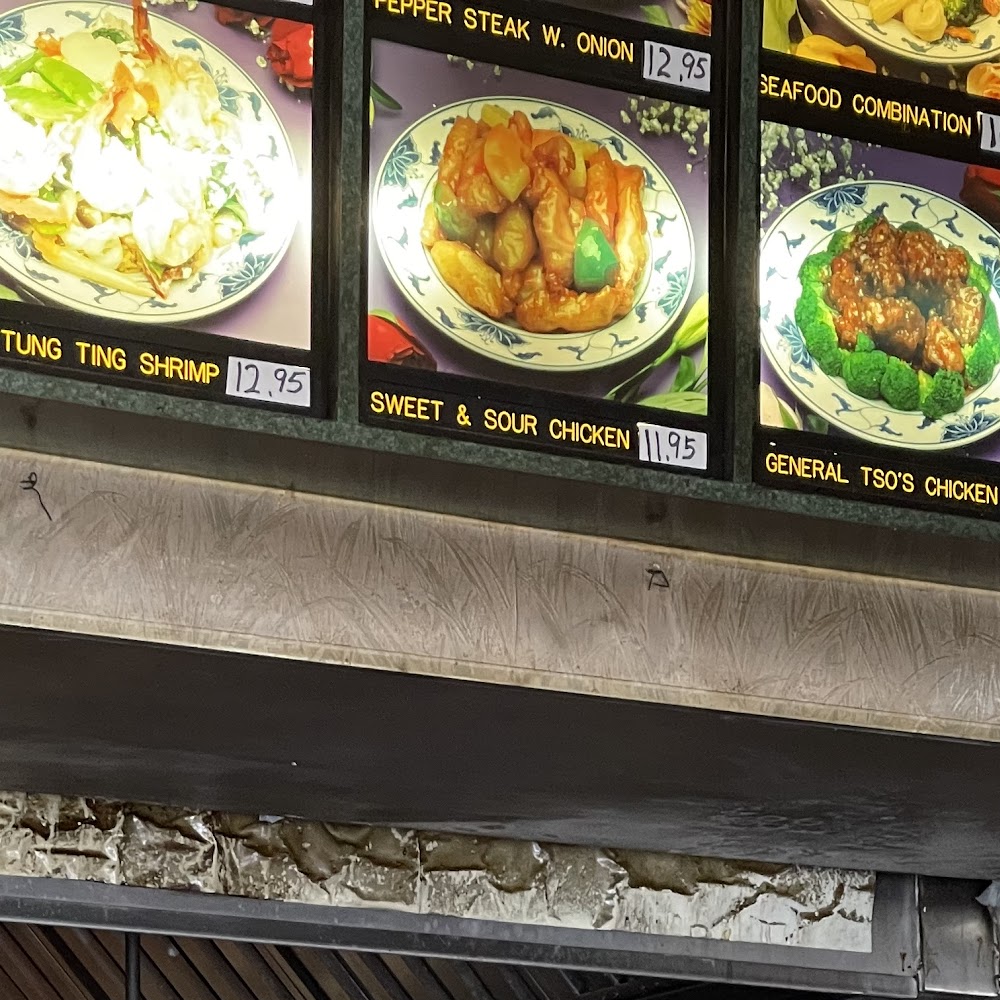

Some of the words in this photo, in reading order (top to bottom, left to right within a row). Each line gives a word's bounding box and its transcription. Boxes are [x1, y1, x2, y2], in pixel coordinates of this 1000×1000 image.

[464, 10, 530, 41] STEAK
[543, 24, 565, 48] W.
[577, 31, 634, 63] ONION
[649, 44, 707, 82] 12.95
[761, 74, 842, 110] SEAFOOD
[852, 93, 972, 137] COMBINATION
[0, 329, 62, 360] TUNG
[76, 341, 126, 371] TING
[140, 352, 219, 384] SHRIMP
[236, 361, 306, 397] 12.95
[370, 391, 443, 421] SWEET
[457, 404, 472, 427] &
[484, 408, 538, 436] SOUR
[549, 418, 630, 450] CHICKEN
[645, 429, 696, 462] 11.95
[766, 452, 849, 484] GENERAL
[861, 466, 914, 493] TSO'S
[925, 476, 998, 506] CHICKEN
